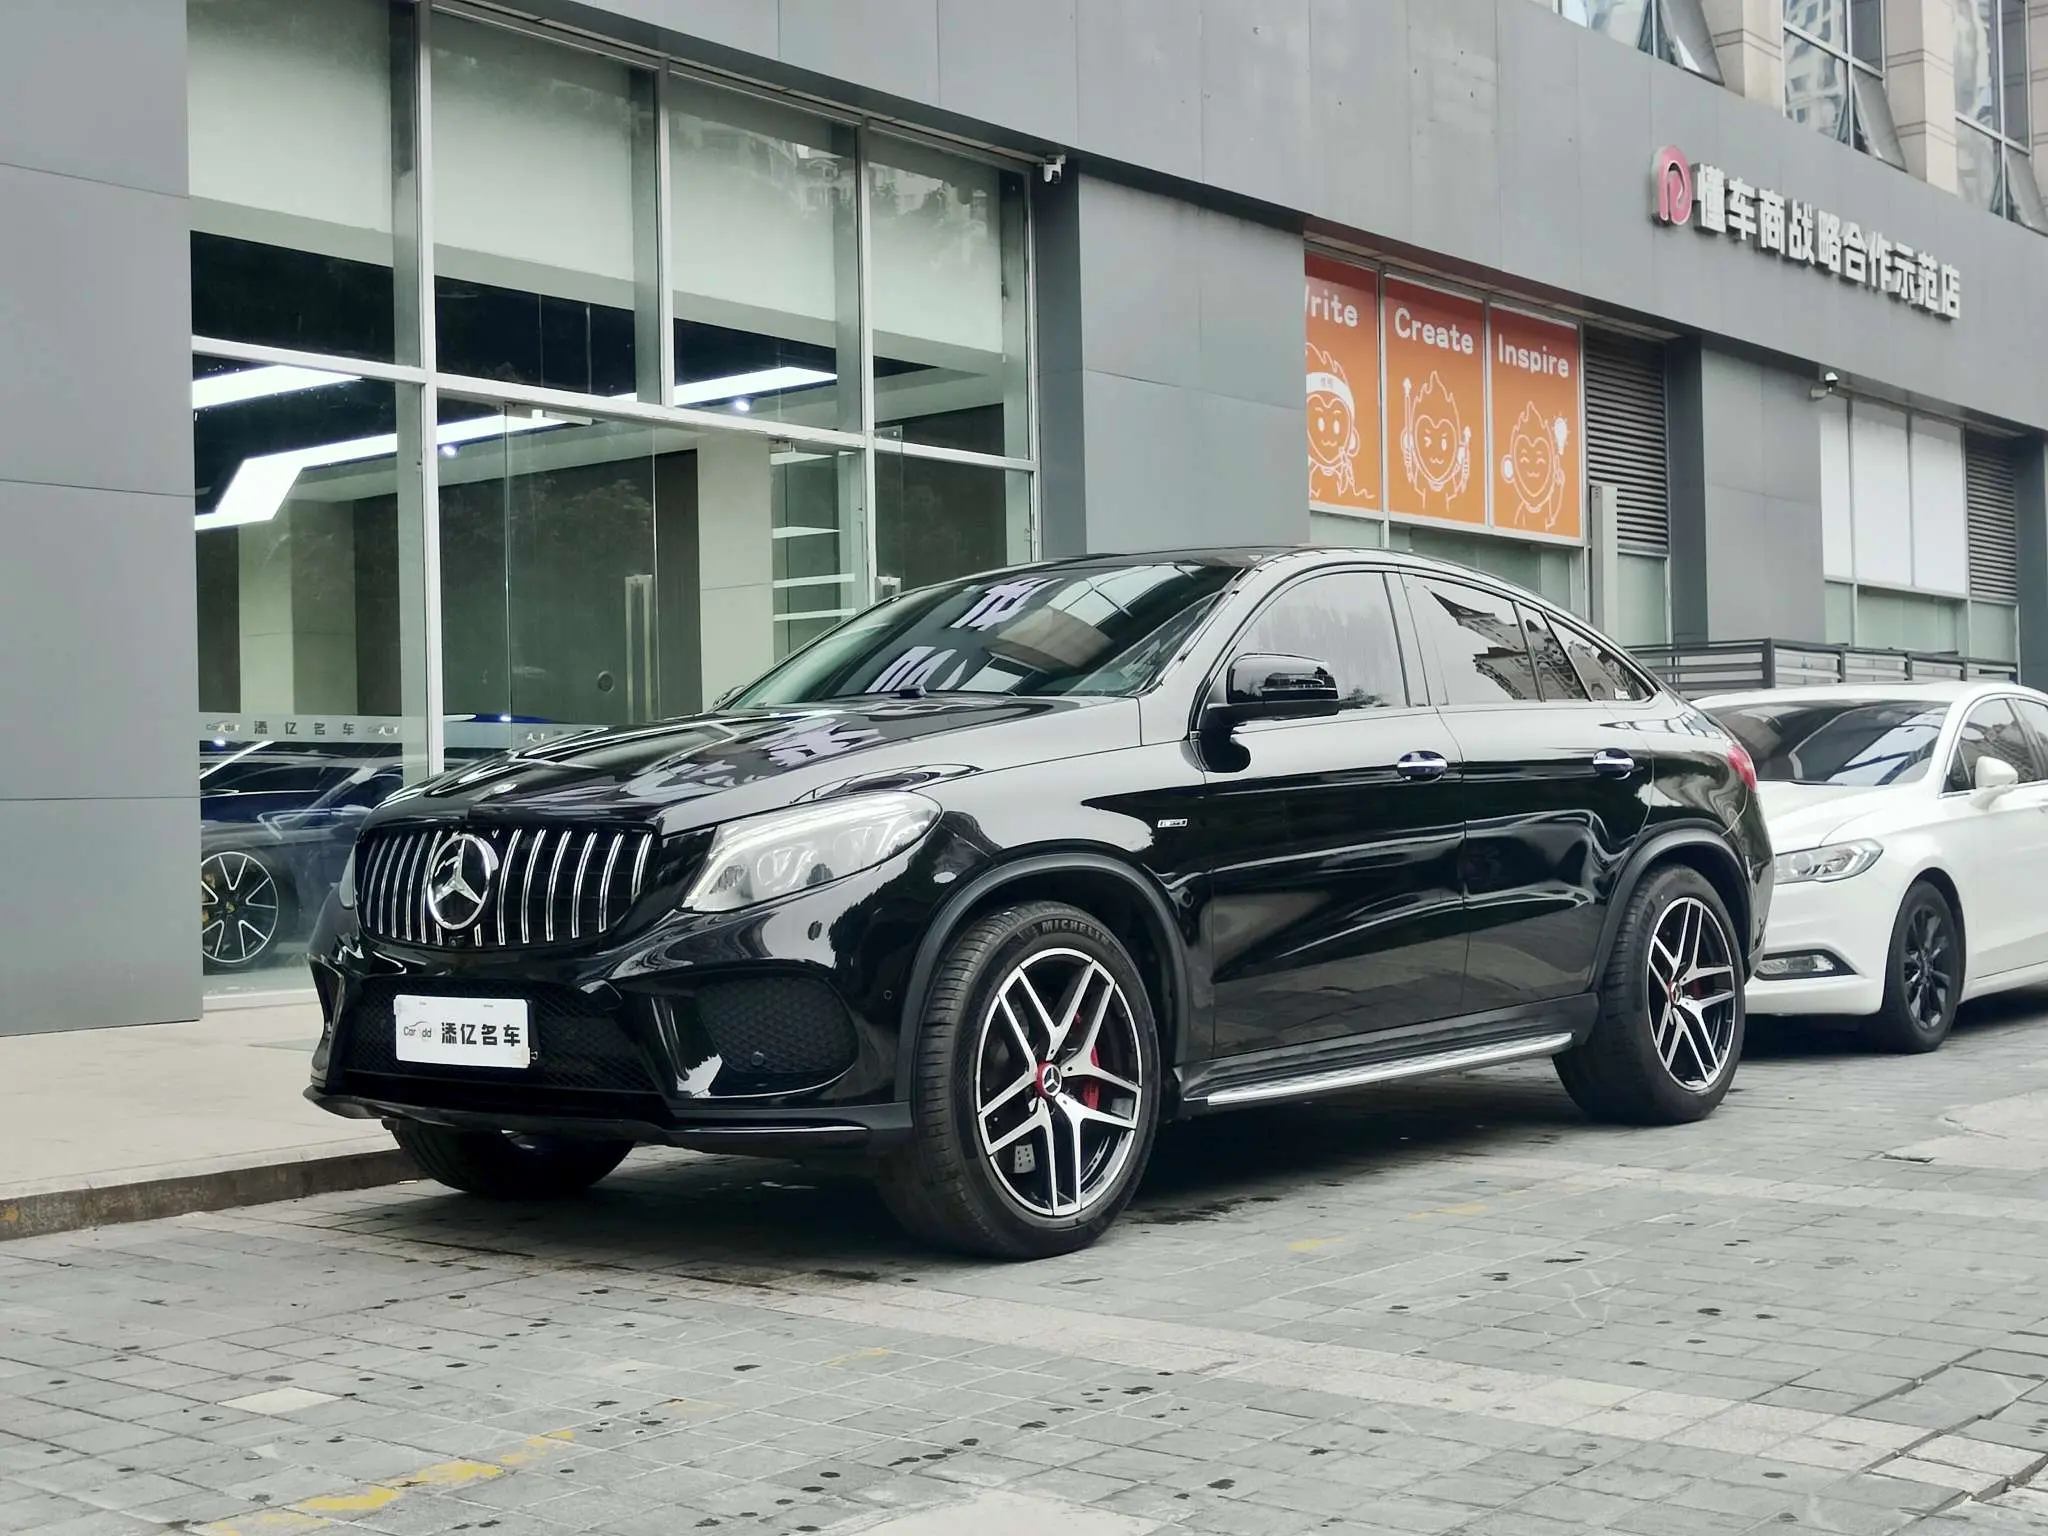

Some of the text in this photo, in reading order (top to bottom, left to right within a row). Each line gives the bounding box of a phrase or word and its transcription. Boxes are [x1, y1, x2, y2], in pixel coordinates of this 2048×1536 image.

[1305, 284, 1358, 327] rite
[1395, 307, 1473, 354] Create
[1498, 334, 1569, 378] Inspire
[441, 1022, 520, 1046] 添亿名车
